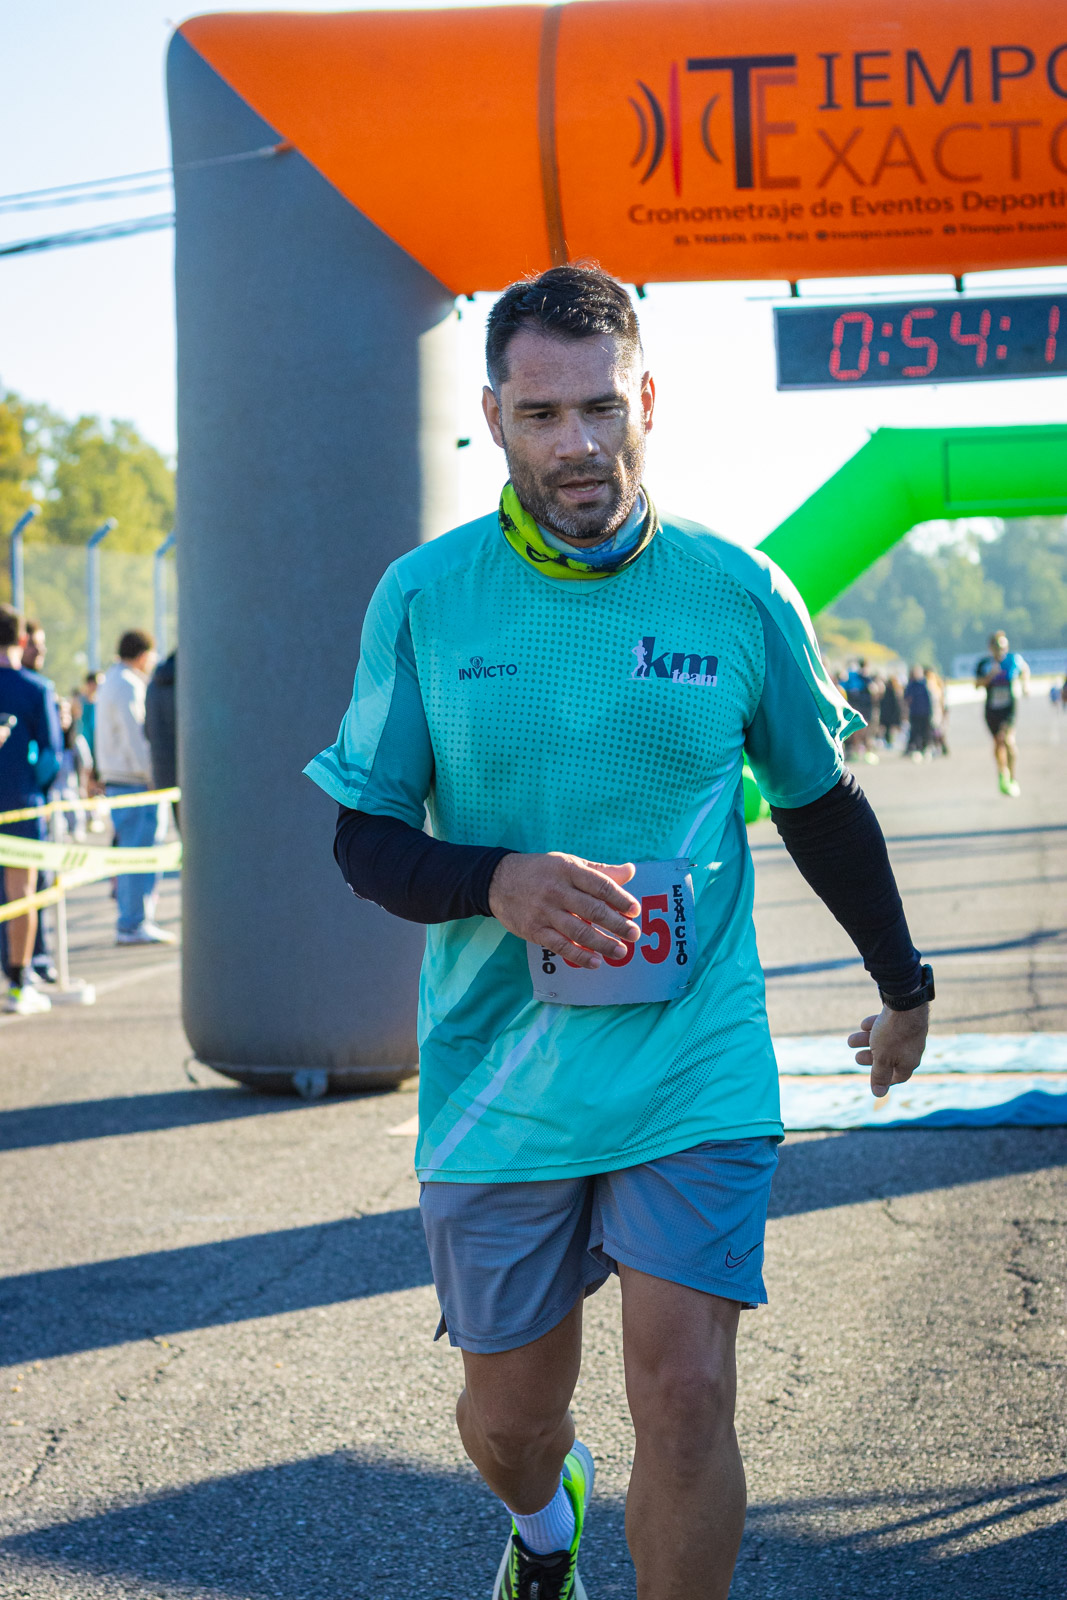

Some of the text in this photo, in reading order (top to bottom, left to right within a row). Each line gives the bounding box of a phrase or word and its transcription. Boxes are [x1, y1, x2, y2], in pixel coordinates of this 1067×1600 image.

[628, 199, 804, 225] Cronometraje
[810, 197, 843, 217] de
[851, 195, 954, 216] Eventos
[459, 663, 518, 681] INVICTO
[636, 636, 719, 679] km
[671, 668, 718, 687] team
[672, 884, 688, 966] EXACTO
